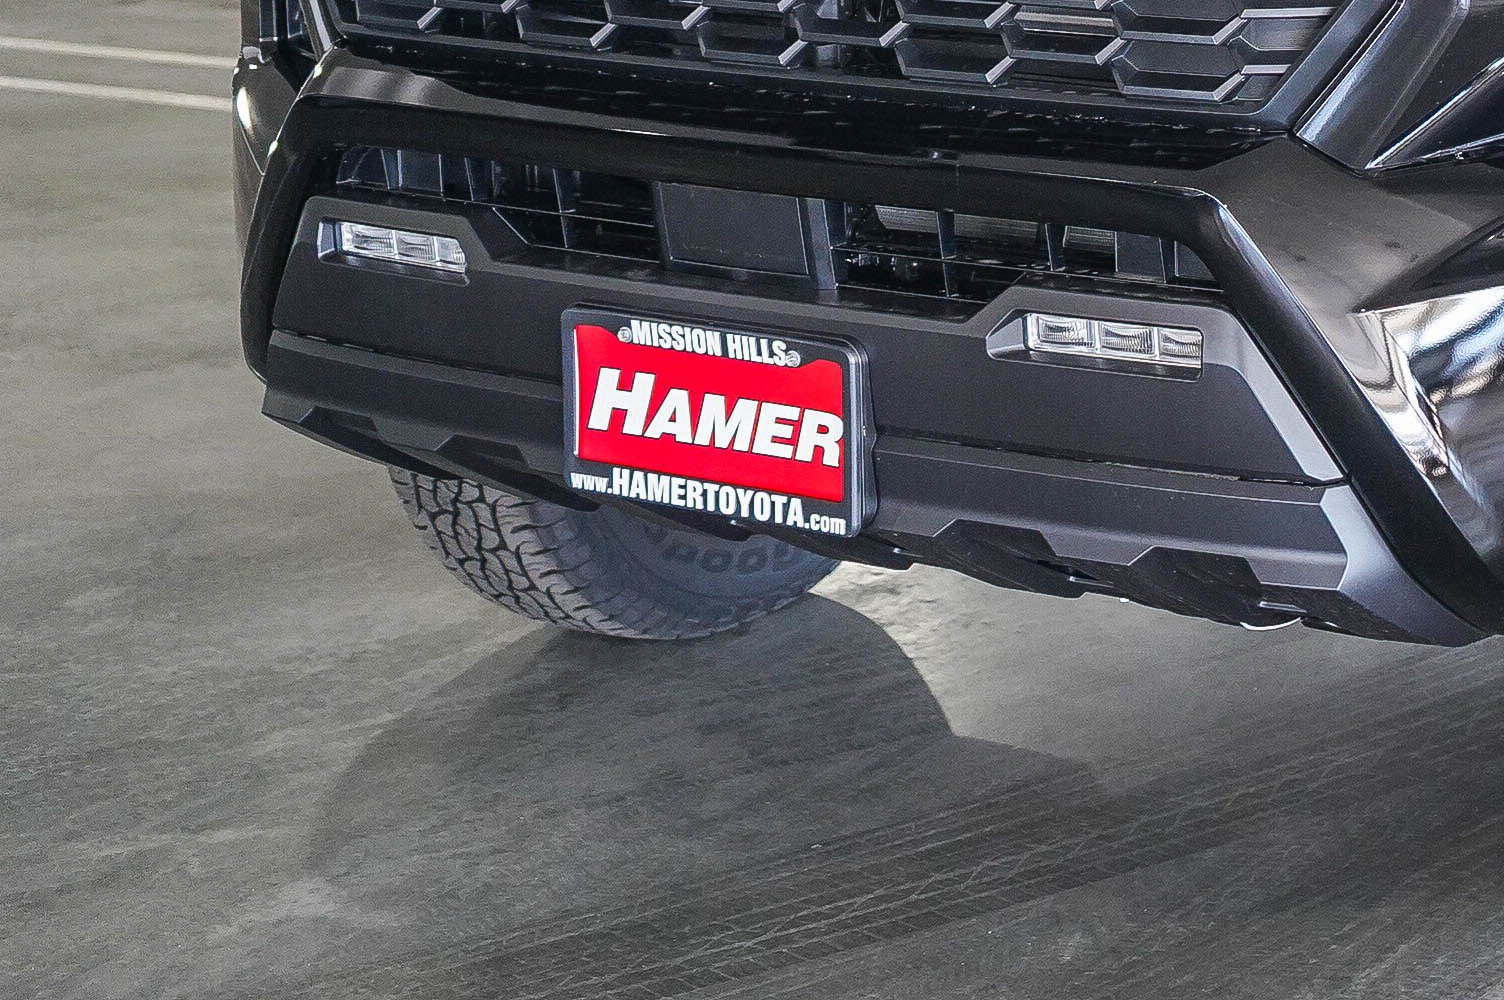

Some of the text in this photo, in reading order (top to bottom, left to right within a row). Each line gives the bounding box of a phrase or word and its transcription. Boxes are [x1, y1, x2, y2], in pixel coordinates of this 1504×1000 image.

[630, 320, 788, 367] MISSION HILLS
[587, 366, 845, 468] HAMER
[569, 467, 846, 535] www.HAMERTOYOTA.com
